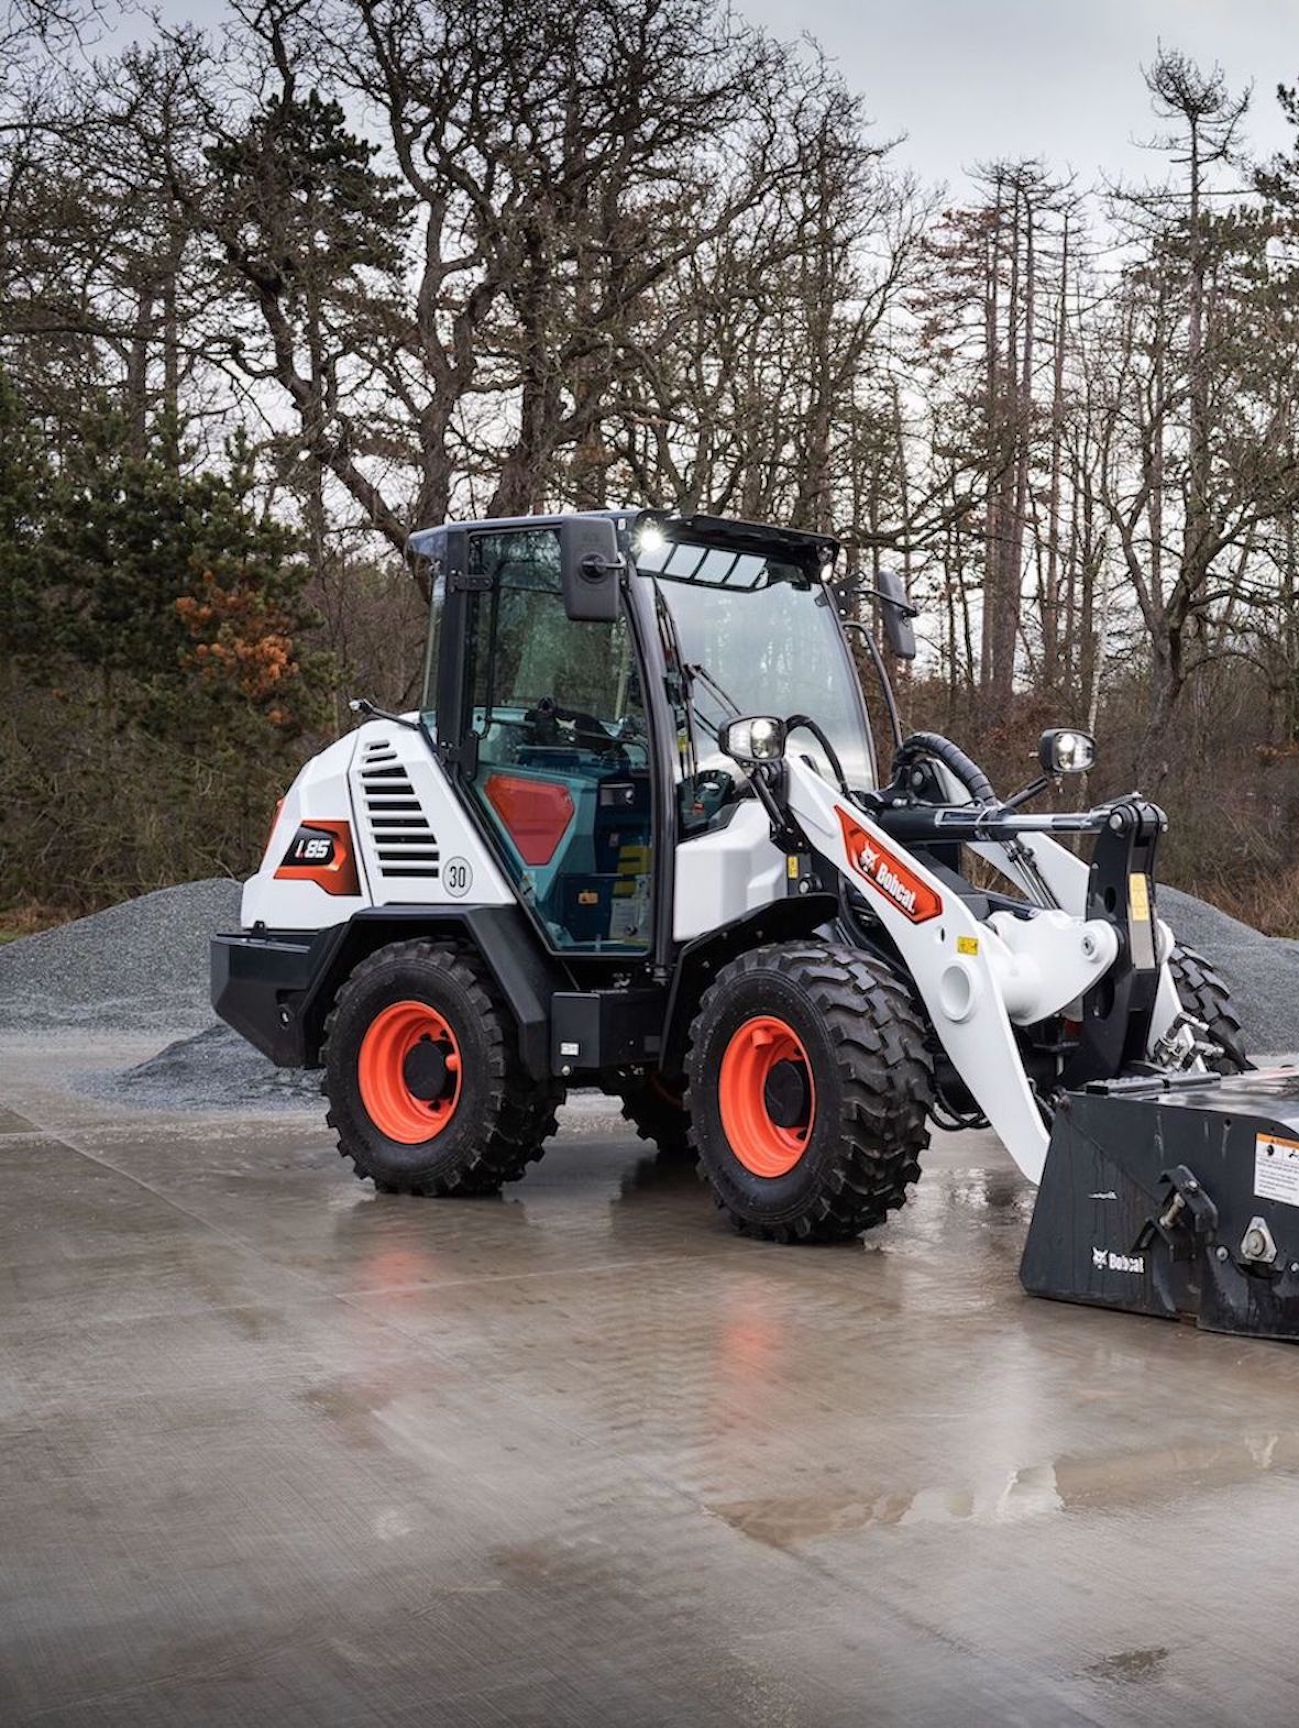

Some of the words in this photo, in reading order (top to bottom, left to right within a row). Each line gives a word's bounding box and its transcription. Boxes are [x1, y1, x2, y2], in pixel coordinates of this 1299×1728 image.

[450, 866, 465, 888] 30
[876, 862, 916, 914] Bobcat
[1108, 1253, 1144, 1273] Bobcat
